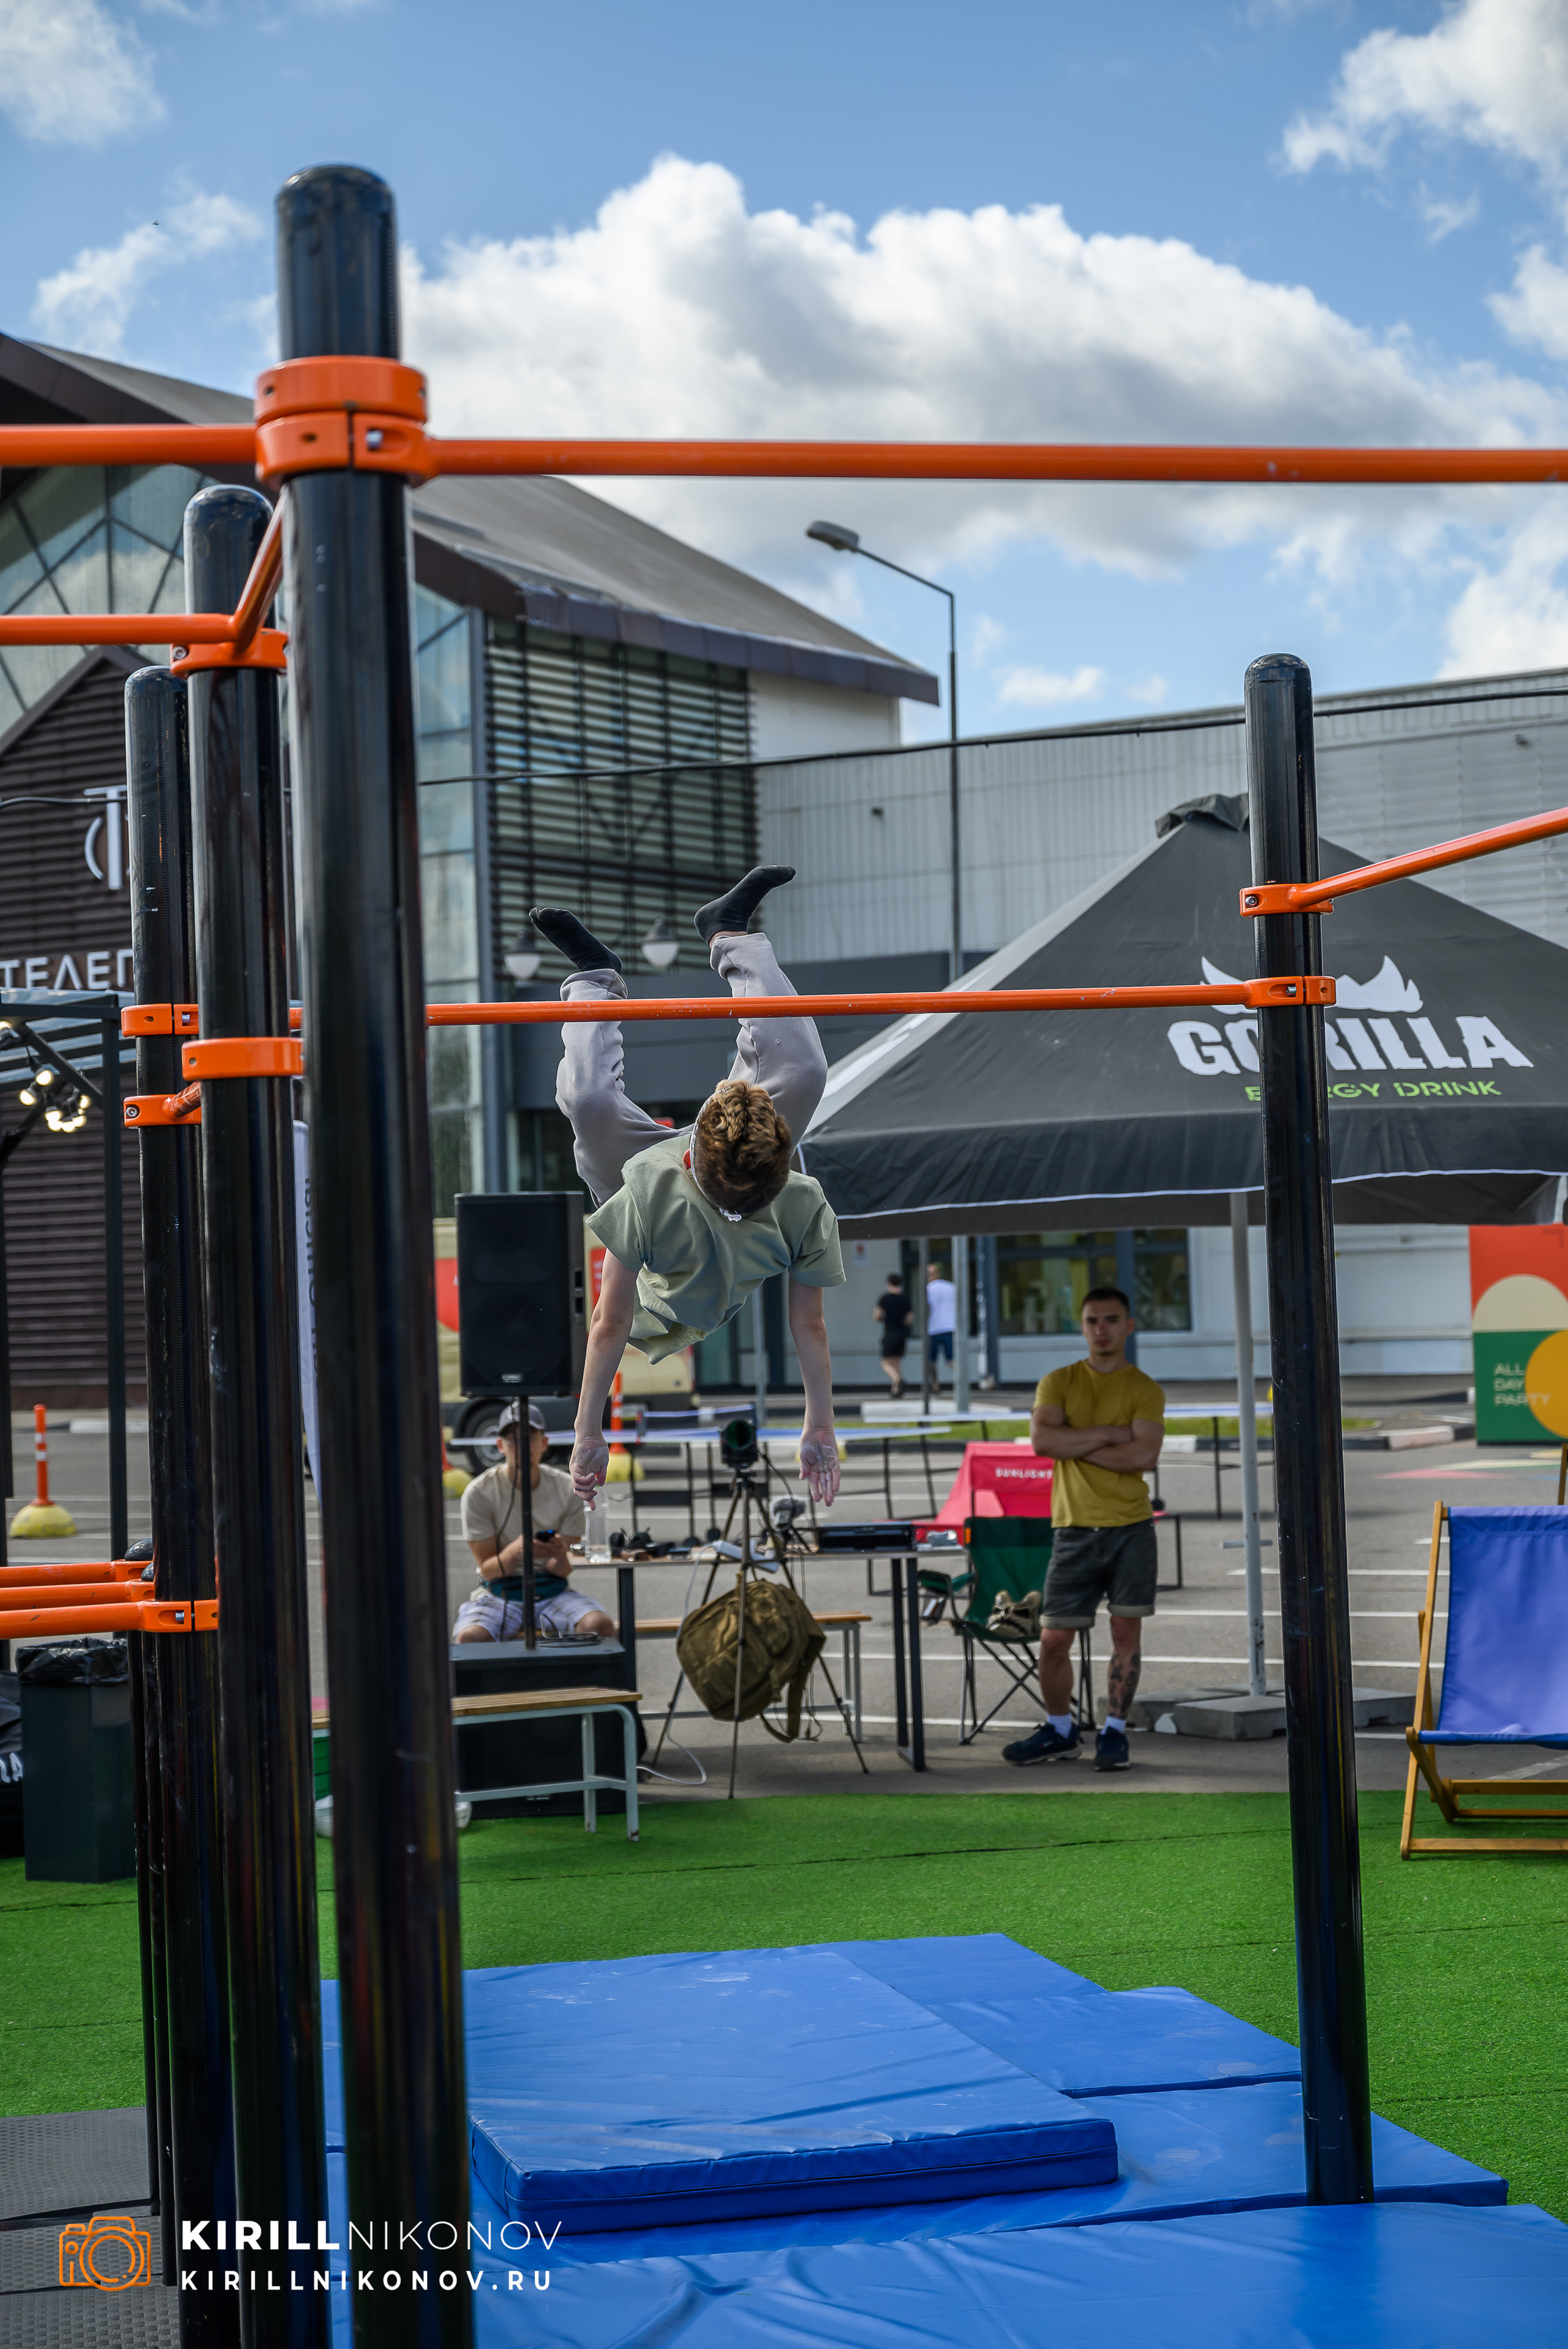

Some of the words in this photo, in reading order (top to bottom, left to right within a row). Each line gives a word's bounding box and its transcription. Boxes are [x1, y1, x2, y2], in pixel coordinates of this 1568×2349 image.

[1244, 1083, 1378, 1102] EGY
[1393, 1081, 1502, 1097] DRINK
[1494, 1363, 1526, 1376] ALL
[1494, 1378, 1525, 1391] DAY
[1494, 1392, 1551, 1406] PARTY
[995, 1467, 1053, 1479] SUNLIGHT
